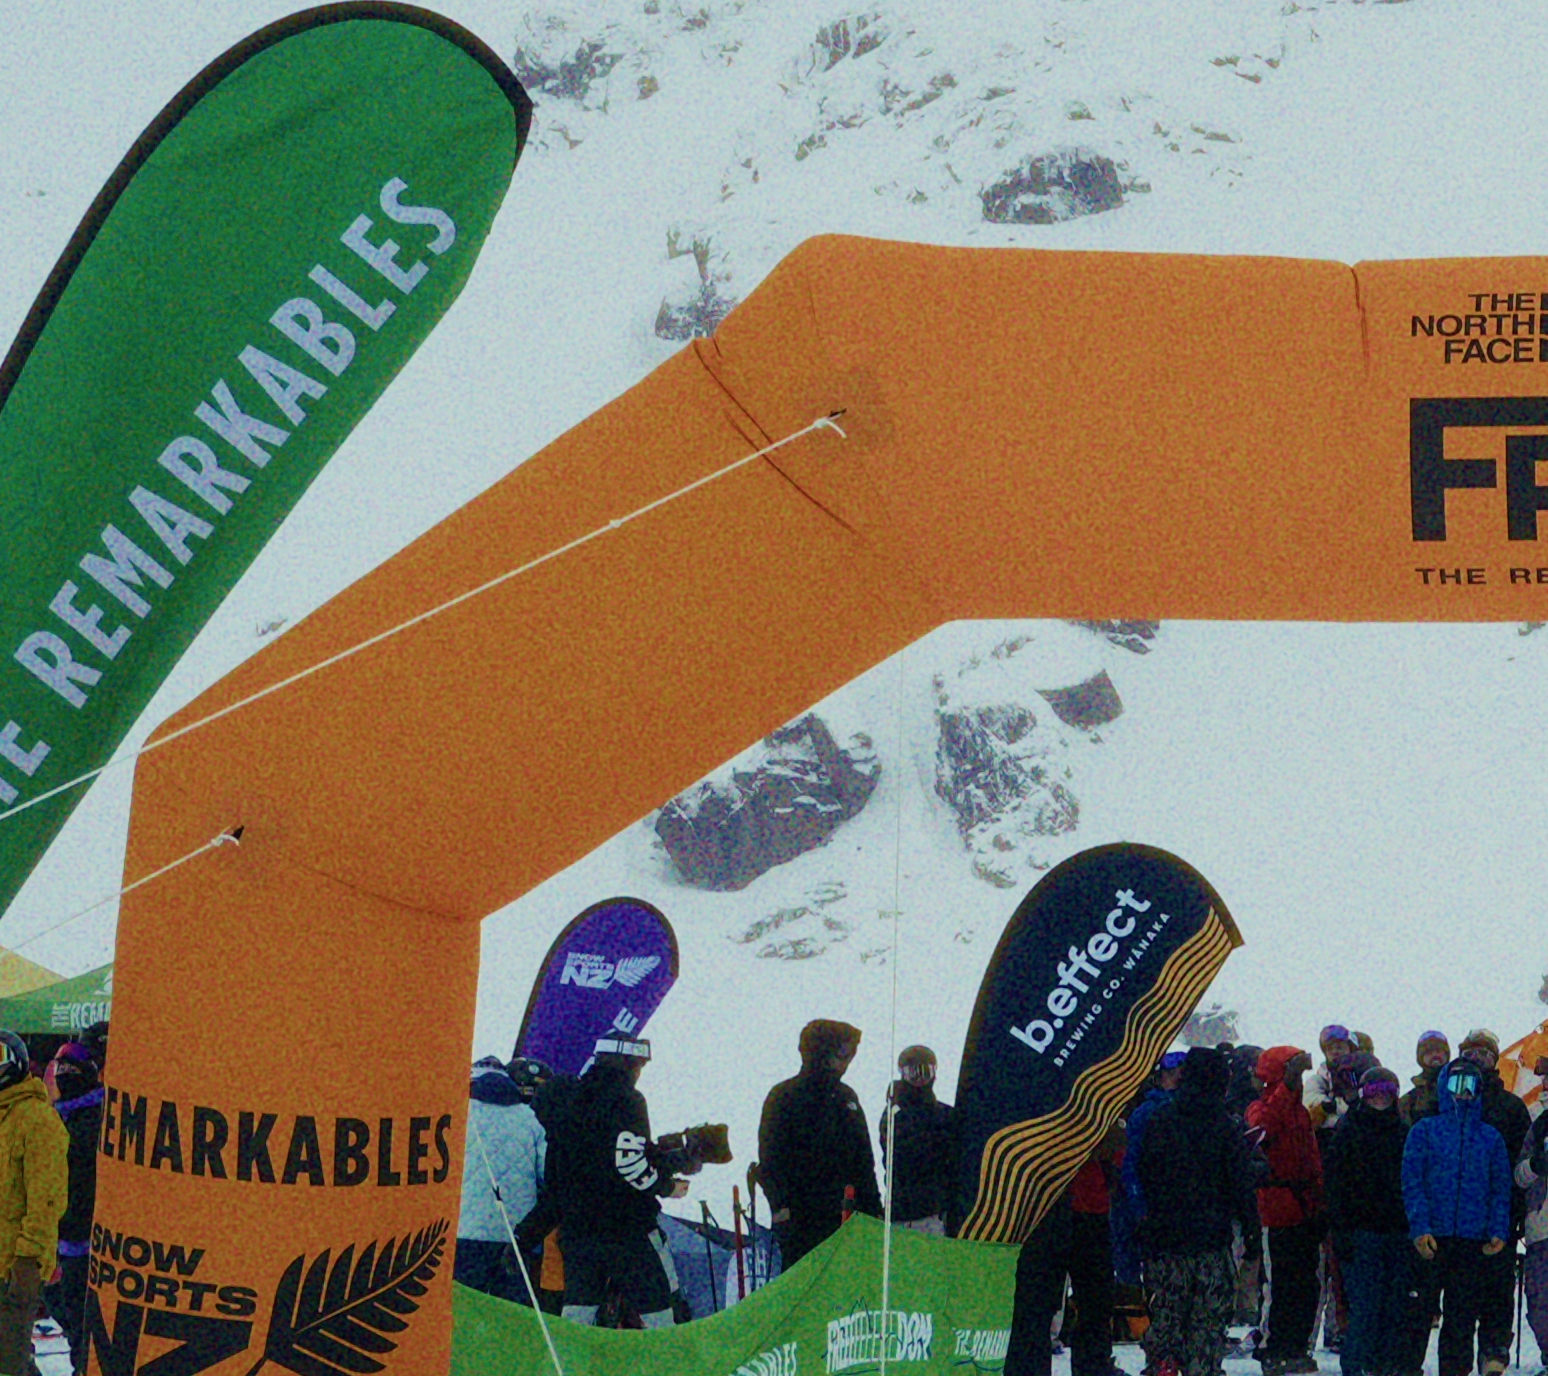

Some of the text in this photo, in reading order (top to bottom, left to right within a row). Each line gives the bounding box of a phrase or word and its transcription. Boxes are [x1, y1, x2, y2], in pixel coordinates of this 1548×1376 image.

[1411, 314, 1535, 336] NORTH
[1468, 293, 1536, 312] THE
[1444, 338, 1535, 363] FACE
[13, 177, 457, 709] REMARKABLES
[1415, 568, 1486, 585] THE
[560, 964, 614, 990] NZ
[1009, 888, 1152, 1055] b.effect
[1053, 1004, 1102, 1068] BREWING
[1102, 977, 1125, 999] CO.
[98, 1084, 452, 1187] EMARKABLES
[92, 1222, 206, 1276] SNOW
[88, 1260, 258, 1317] SPORTS
